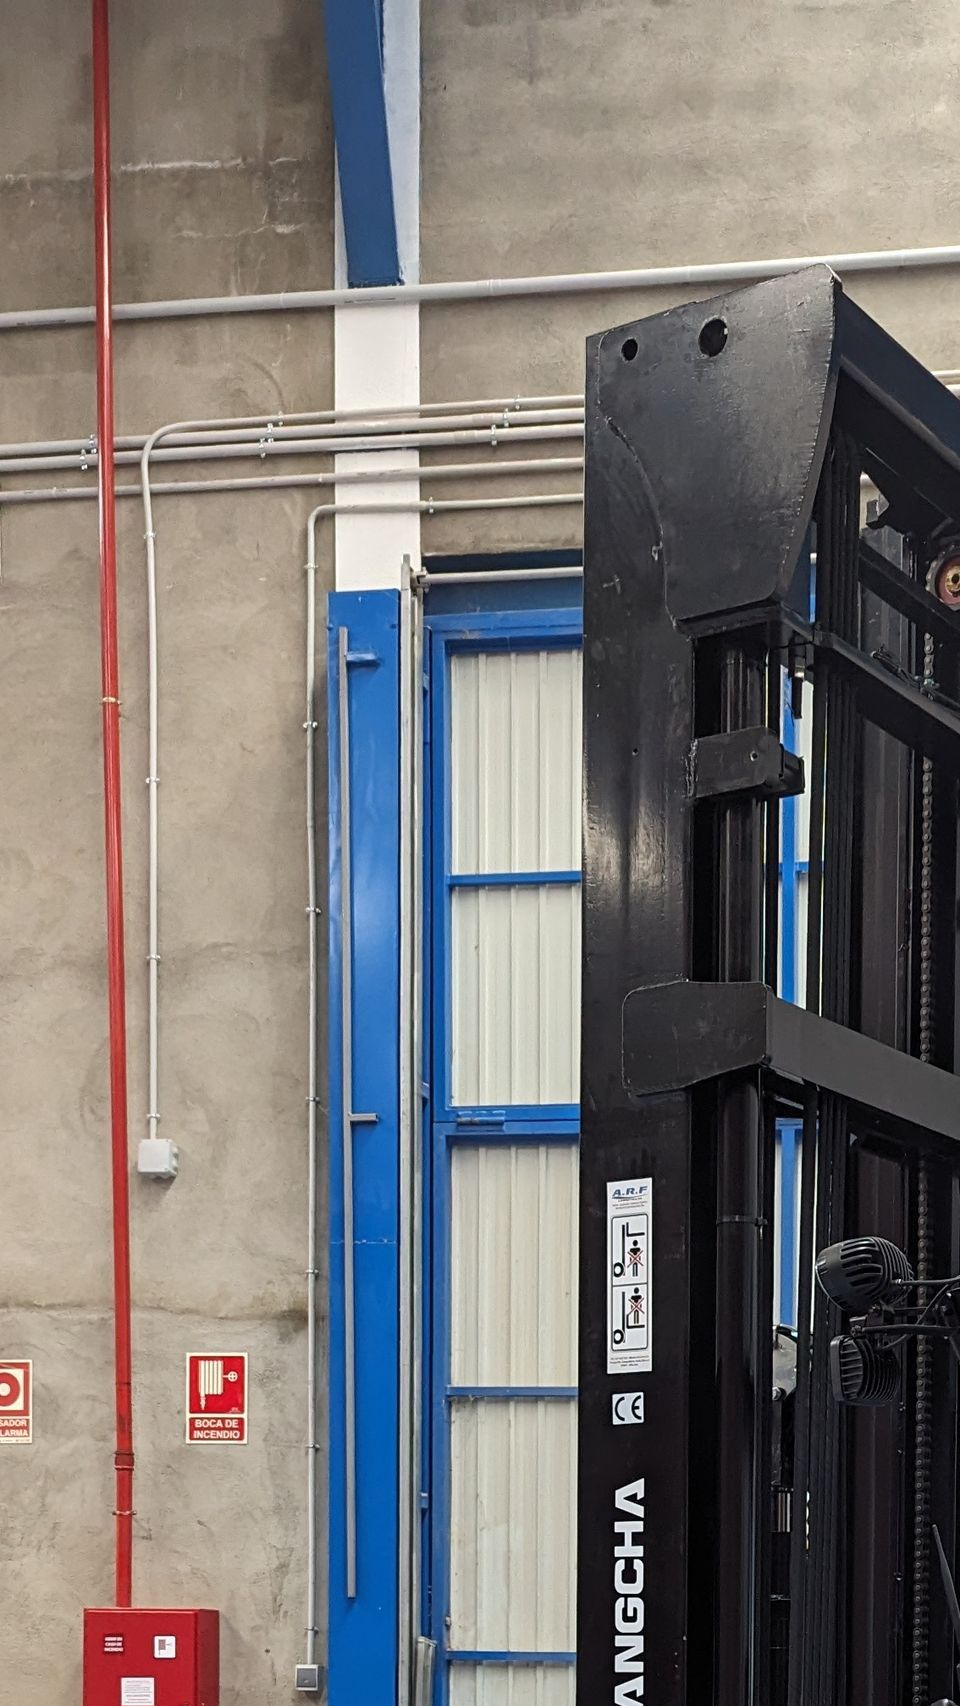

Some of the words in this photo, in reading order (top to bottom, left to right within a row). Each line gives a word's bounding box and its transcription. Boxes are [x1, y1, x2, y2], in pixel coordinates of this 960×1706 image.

[612, 1185, 648, 1197] A.R.F
[614, 1395, 642, 1422] CE
[194, 1419, 223, 1428] BOCA
[225, 1419, 239, 1428] DE
[193, 1430, 240, 1439] INCENDIO
